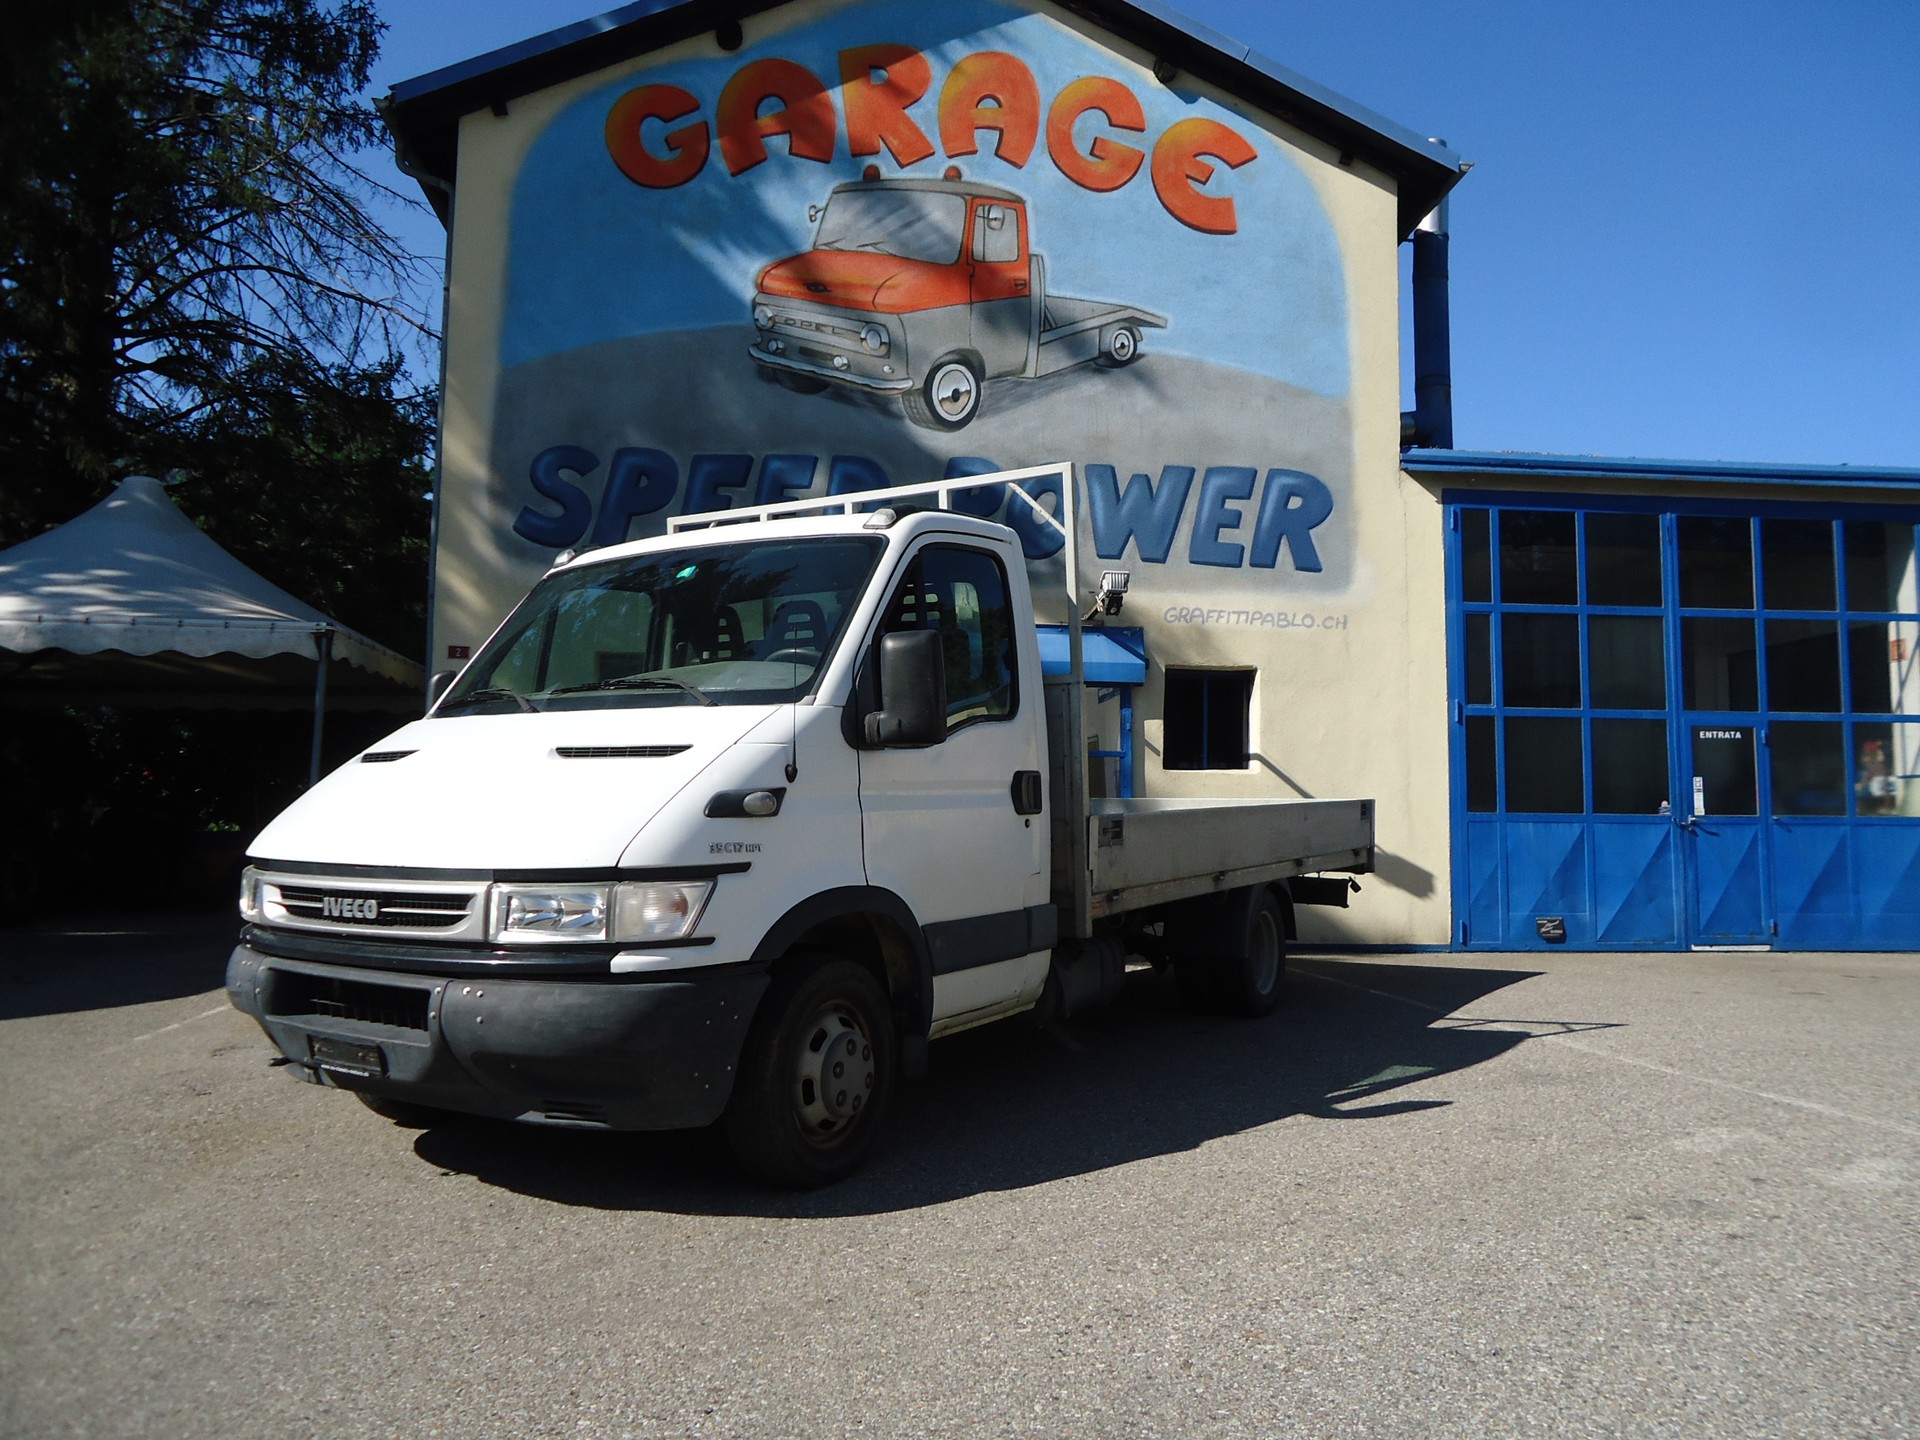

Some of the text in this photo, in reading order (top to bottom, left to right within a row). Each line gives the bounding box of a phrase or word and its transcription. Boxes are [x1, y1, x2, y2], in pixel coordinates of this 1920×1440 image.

[605, 43, 1258, 235] GARAGE
[1163, 606, 1349, 630] GRAFFITIPABLO.CH
[1699, 730, 1742, 739] ENTRATA
[323, 896, 378, 920] IVECO
